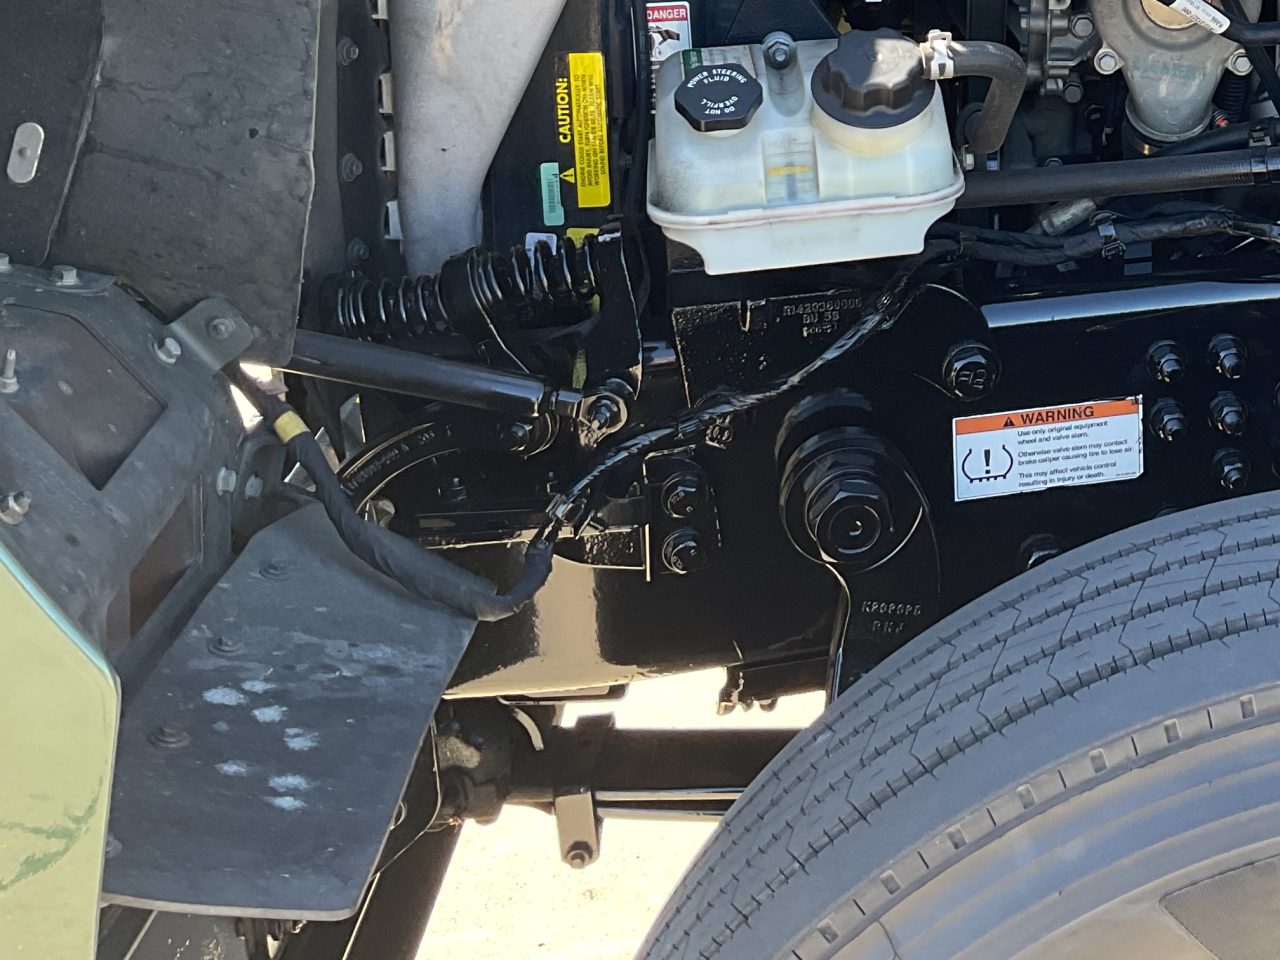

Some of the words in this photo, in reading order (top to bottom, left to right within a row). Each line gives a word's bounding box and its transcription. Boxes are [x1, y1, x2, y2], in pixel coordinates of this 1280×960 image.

[646, 9, 687, 20] DANGER
[574, 74, 580, 82] TO
[687, 71, 709, 88] POWER
[712, 68, 748, 84] STEERING
[703, 75, 730, 84] FLUID
[701, 96, 738, 109] OVERFILL
[556, 78, 572, 143] CAUTION:
[592, 148, 598, 157] ON
[1020, 406, 1095, 425] WARNING
[1048, 424, 1073, 433] original
[1074, 420, 1108, 430] equipment
[1018, 437, 1037, 445] wheel
[1018, 449, 1052, 458] Otherwise
[1038, 456, 1060, 464] caliper
[1062, 452, 1088, 461] causing
[1069, 464, 1092, 472] vehicle
[1094, 461, 1117, 470] control
[1018, 480, 1048, 488] resulting
